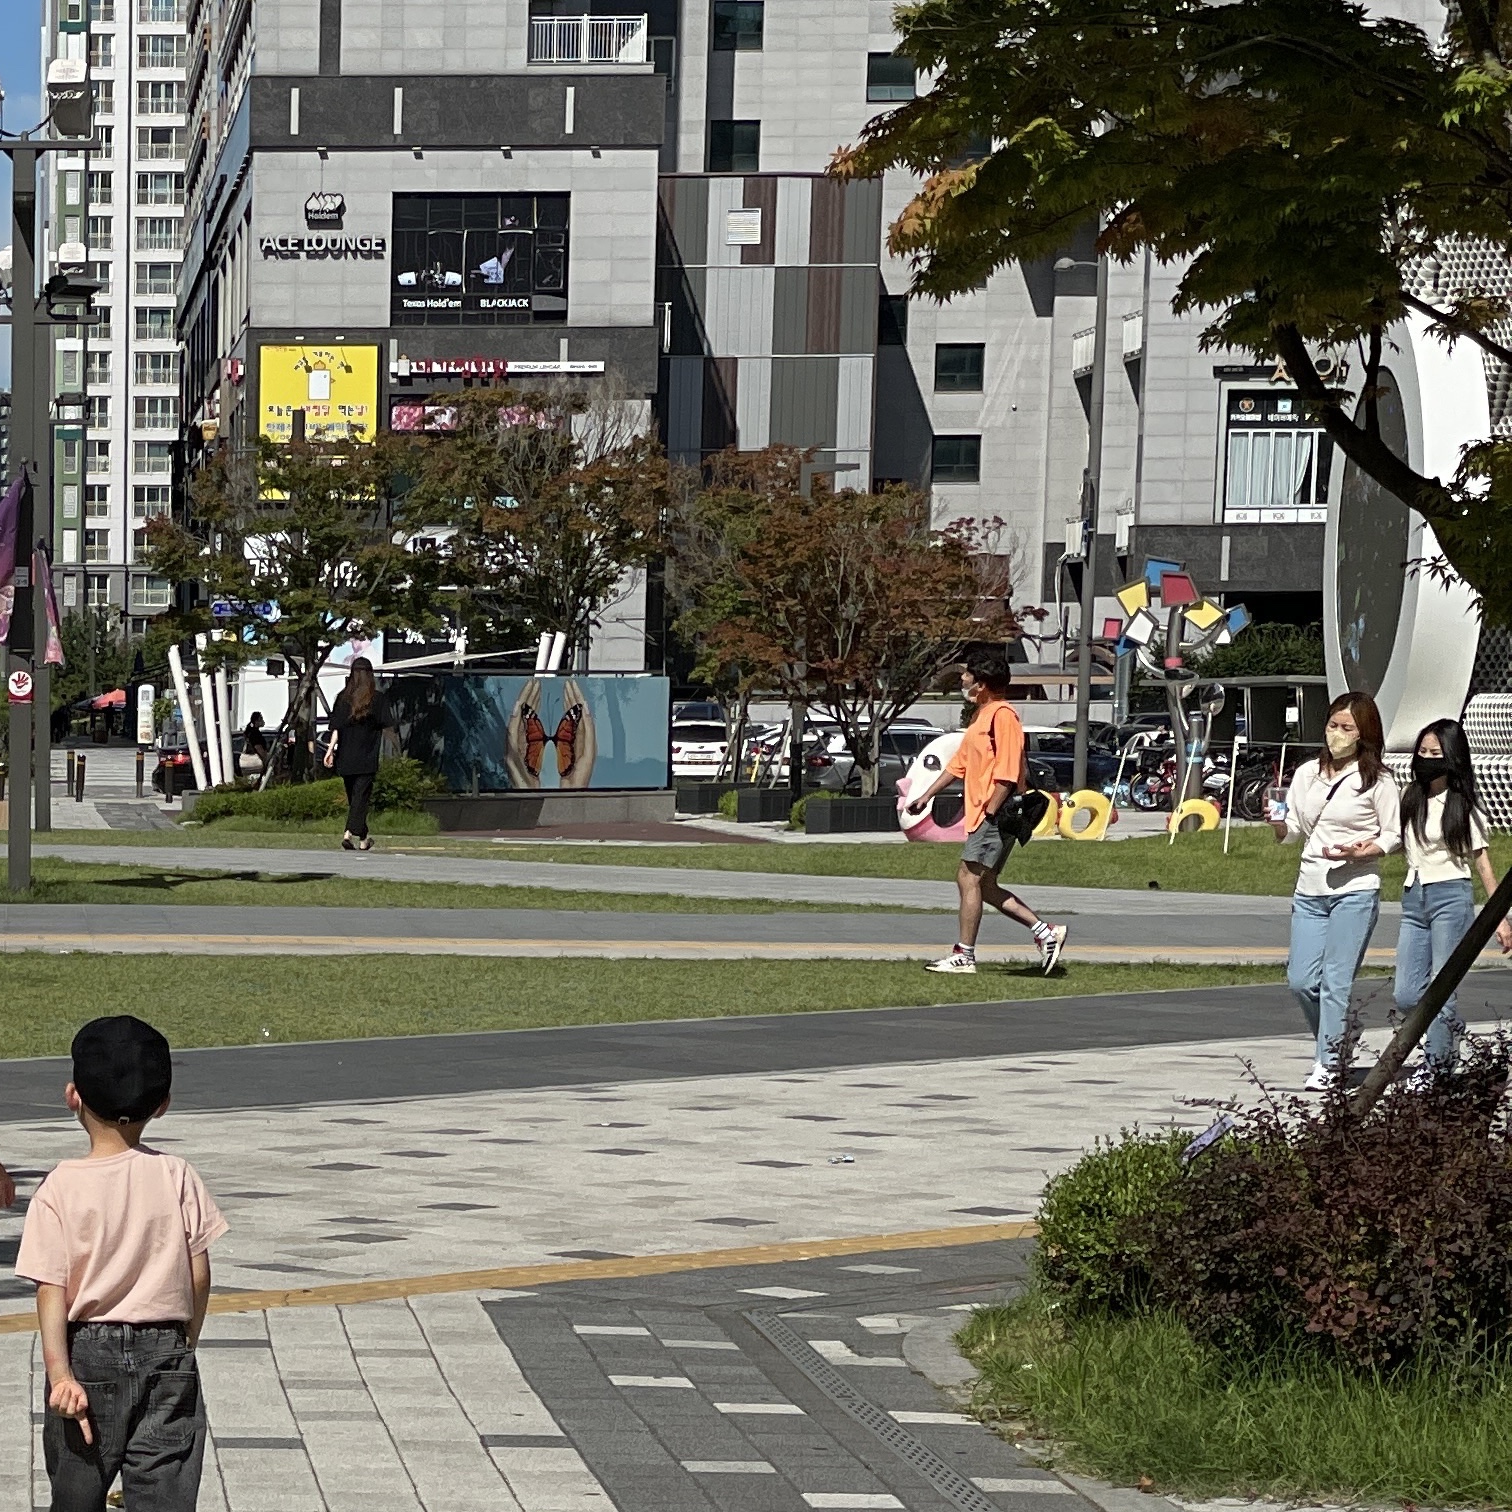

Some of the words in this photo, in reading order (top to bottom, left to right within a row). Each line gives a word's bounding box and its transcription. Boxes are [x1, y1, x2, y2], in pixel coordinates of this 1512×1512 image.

[261, 233, 300, 251] ACE
[303, 232, 384, 251] LOUNGE
[403, 299, 426, 308] Texas
[426, 297, 462, 308] Hold'em
[479, 298, 529, 308] BLACKJACK
